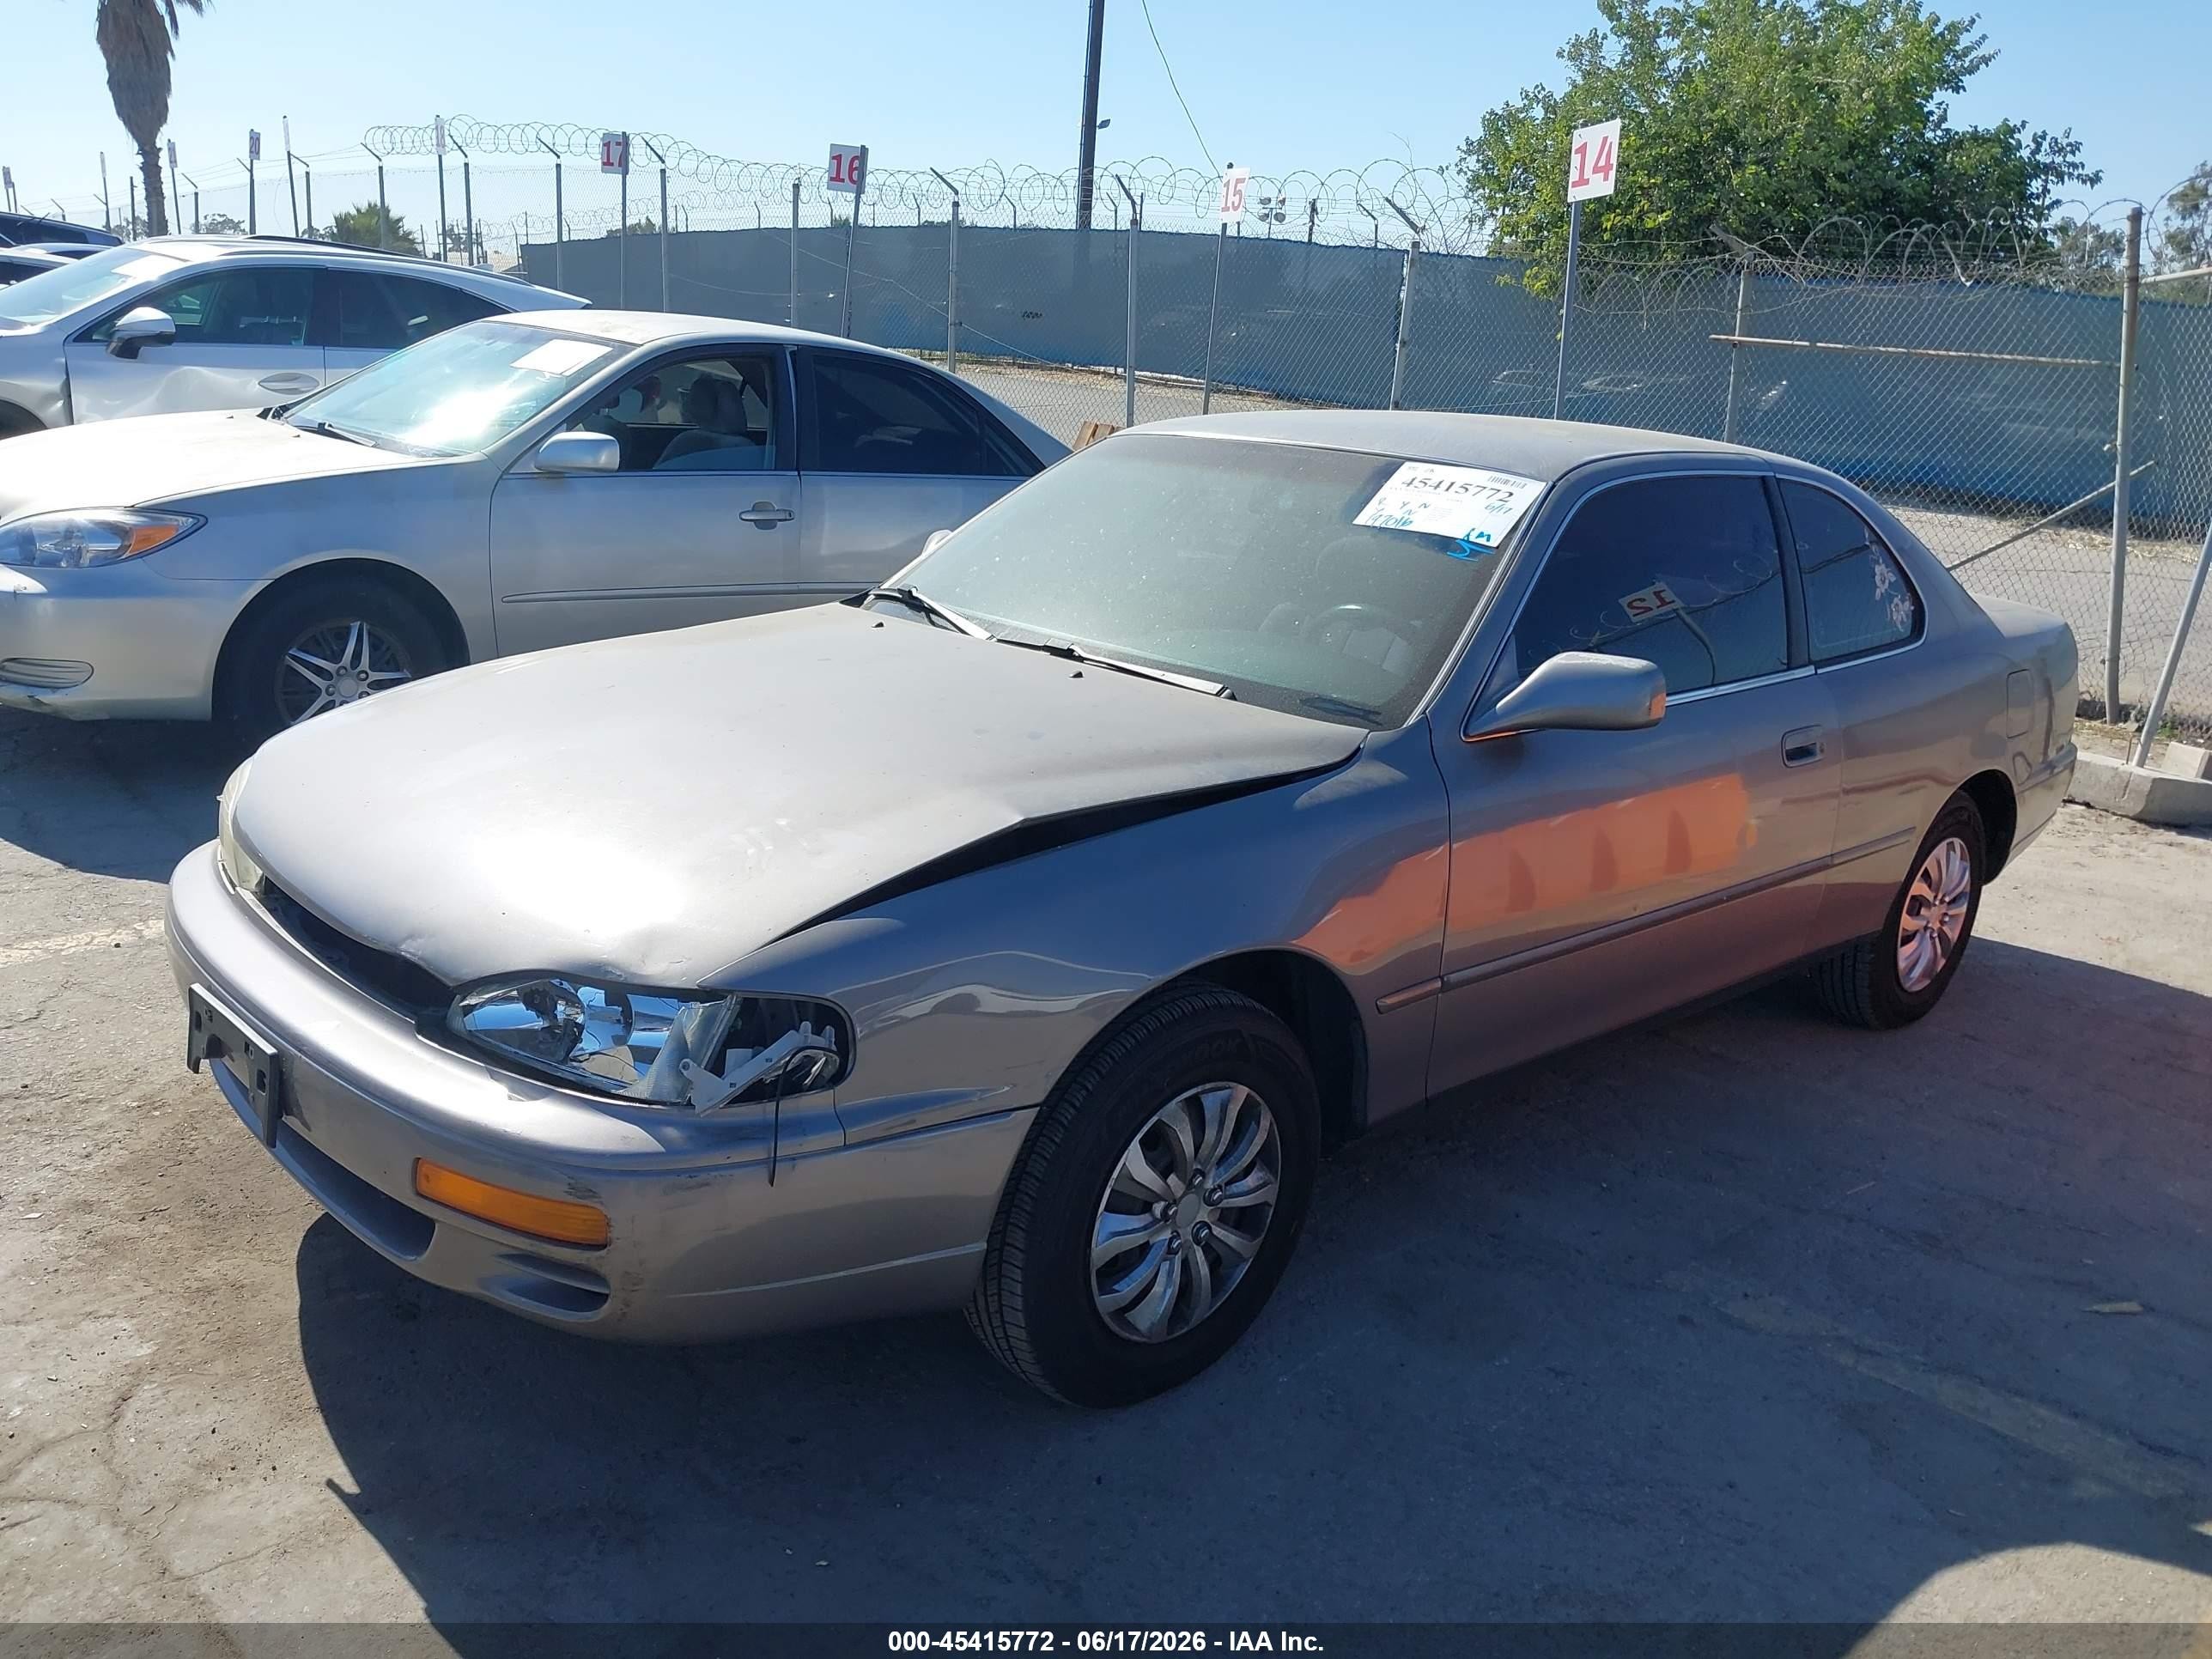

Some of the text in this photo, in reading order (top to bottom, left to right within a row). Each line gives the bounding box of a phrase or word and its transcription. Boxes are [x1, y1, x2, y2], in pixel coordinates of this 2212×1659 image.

[249, 137, 260, 155] 20
[830, 154, 860, 185] 16
[1571, 136, 1614, 189] 14
[1221, 177, 1247, 213] 15
[1401, 476, 1515, 503] 45415772
